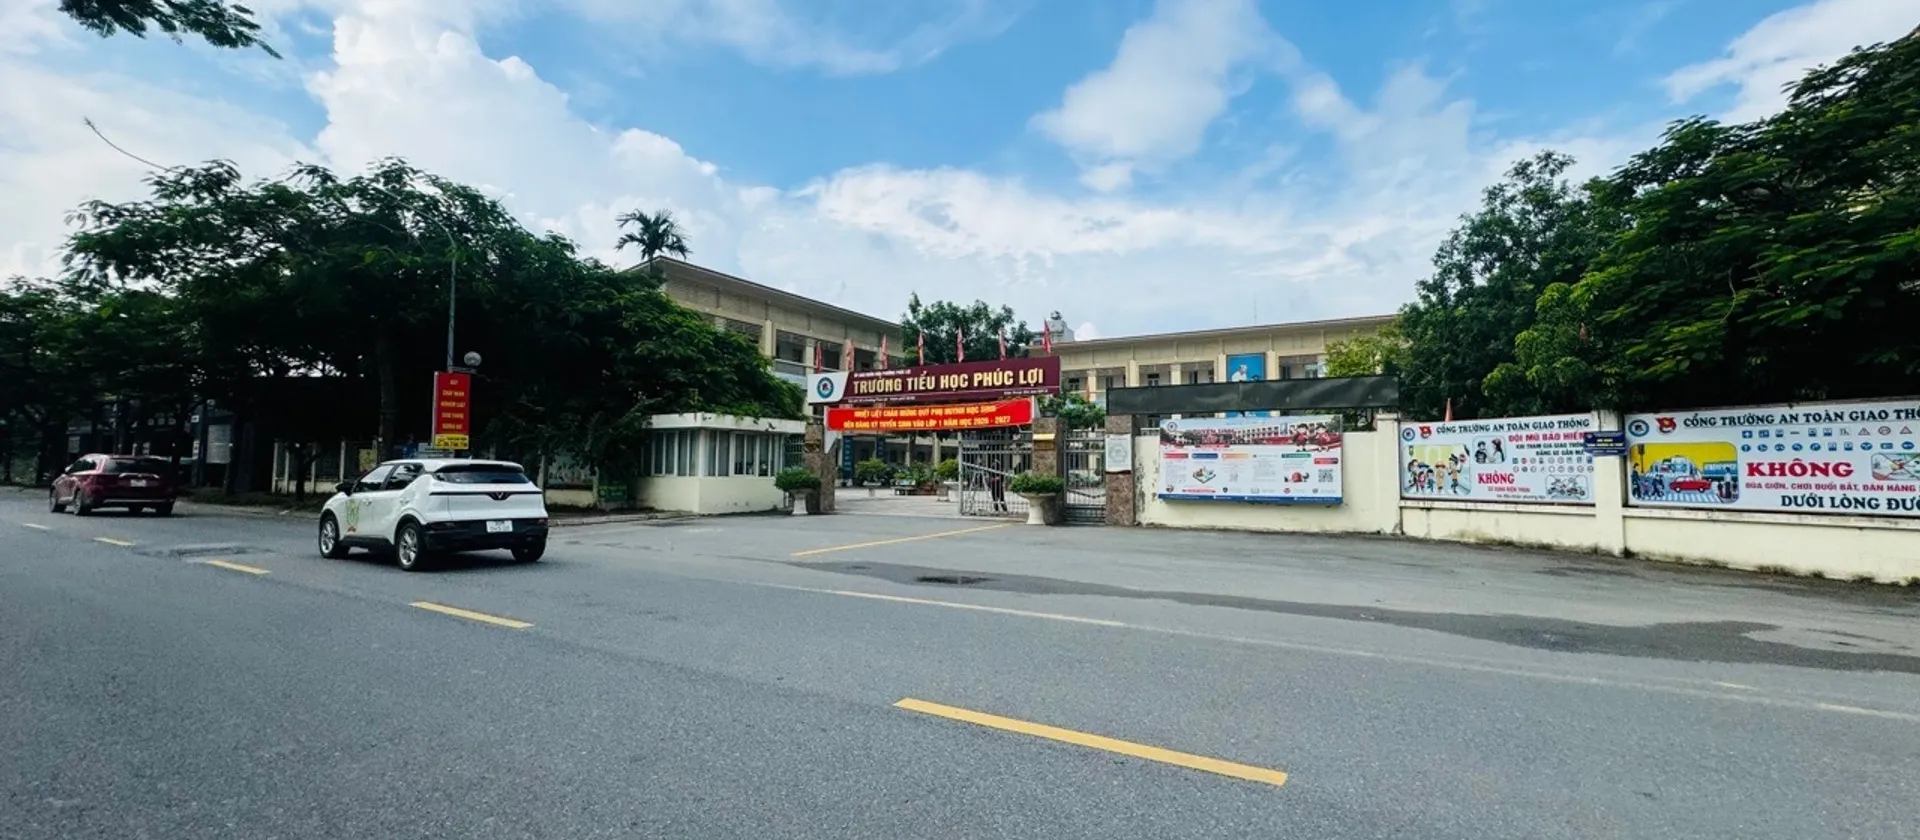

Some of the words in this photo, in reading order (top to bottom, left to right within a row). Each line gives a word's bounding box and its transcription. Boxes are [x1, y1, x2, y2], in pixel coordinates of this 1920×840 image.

[853, 376, 902, 394] TRƯỜNG
[906, 371, 935, 391] TIỂU
[940, 374, 969, 392] HỌC
[973, 367, 1014, 387] PHÚC
[1019, 367, 1044, 387] LỢI
[1436, 423, 1456, 435] CỔNG
[1458, 422, 1491, 434] TRƯỜNG
[1493, 423, 1505, 432] AN
[1506, 421, 1531, 432] TOÀN
[1532, 420, 1556, 430] GIAO
[1557, 418, 1590, 429] THÔNG
[1683, 412, 1717, 428] CỔNG
[1719, 412, 1775, 427] TRƯỜNG
[1778, 413, 1799, 425] AN
[1802, 409, 1845, 424] TOÀN
[1848, 409, 1889, 422] GIAO
[1745, 457, 1854, 479] KHÔNG
[1477, 470, 1516, 485] KHÔNG
[1790, 481, 1813, 490] CHƠI
[1780, 492, 1825, 509] DƯỚI
[1829, 492, 1881, 510] LÒNG
